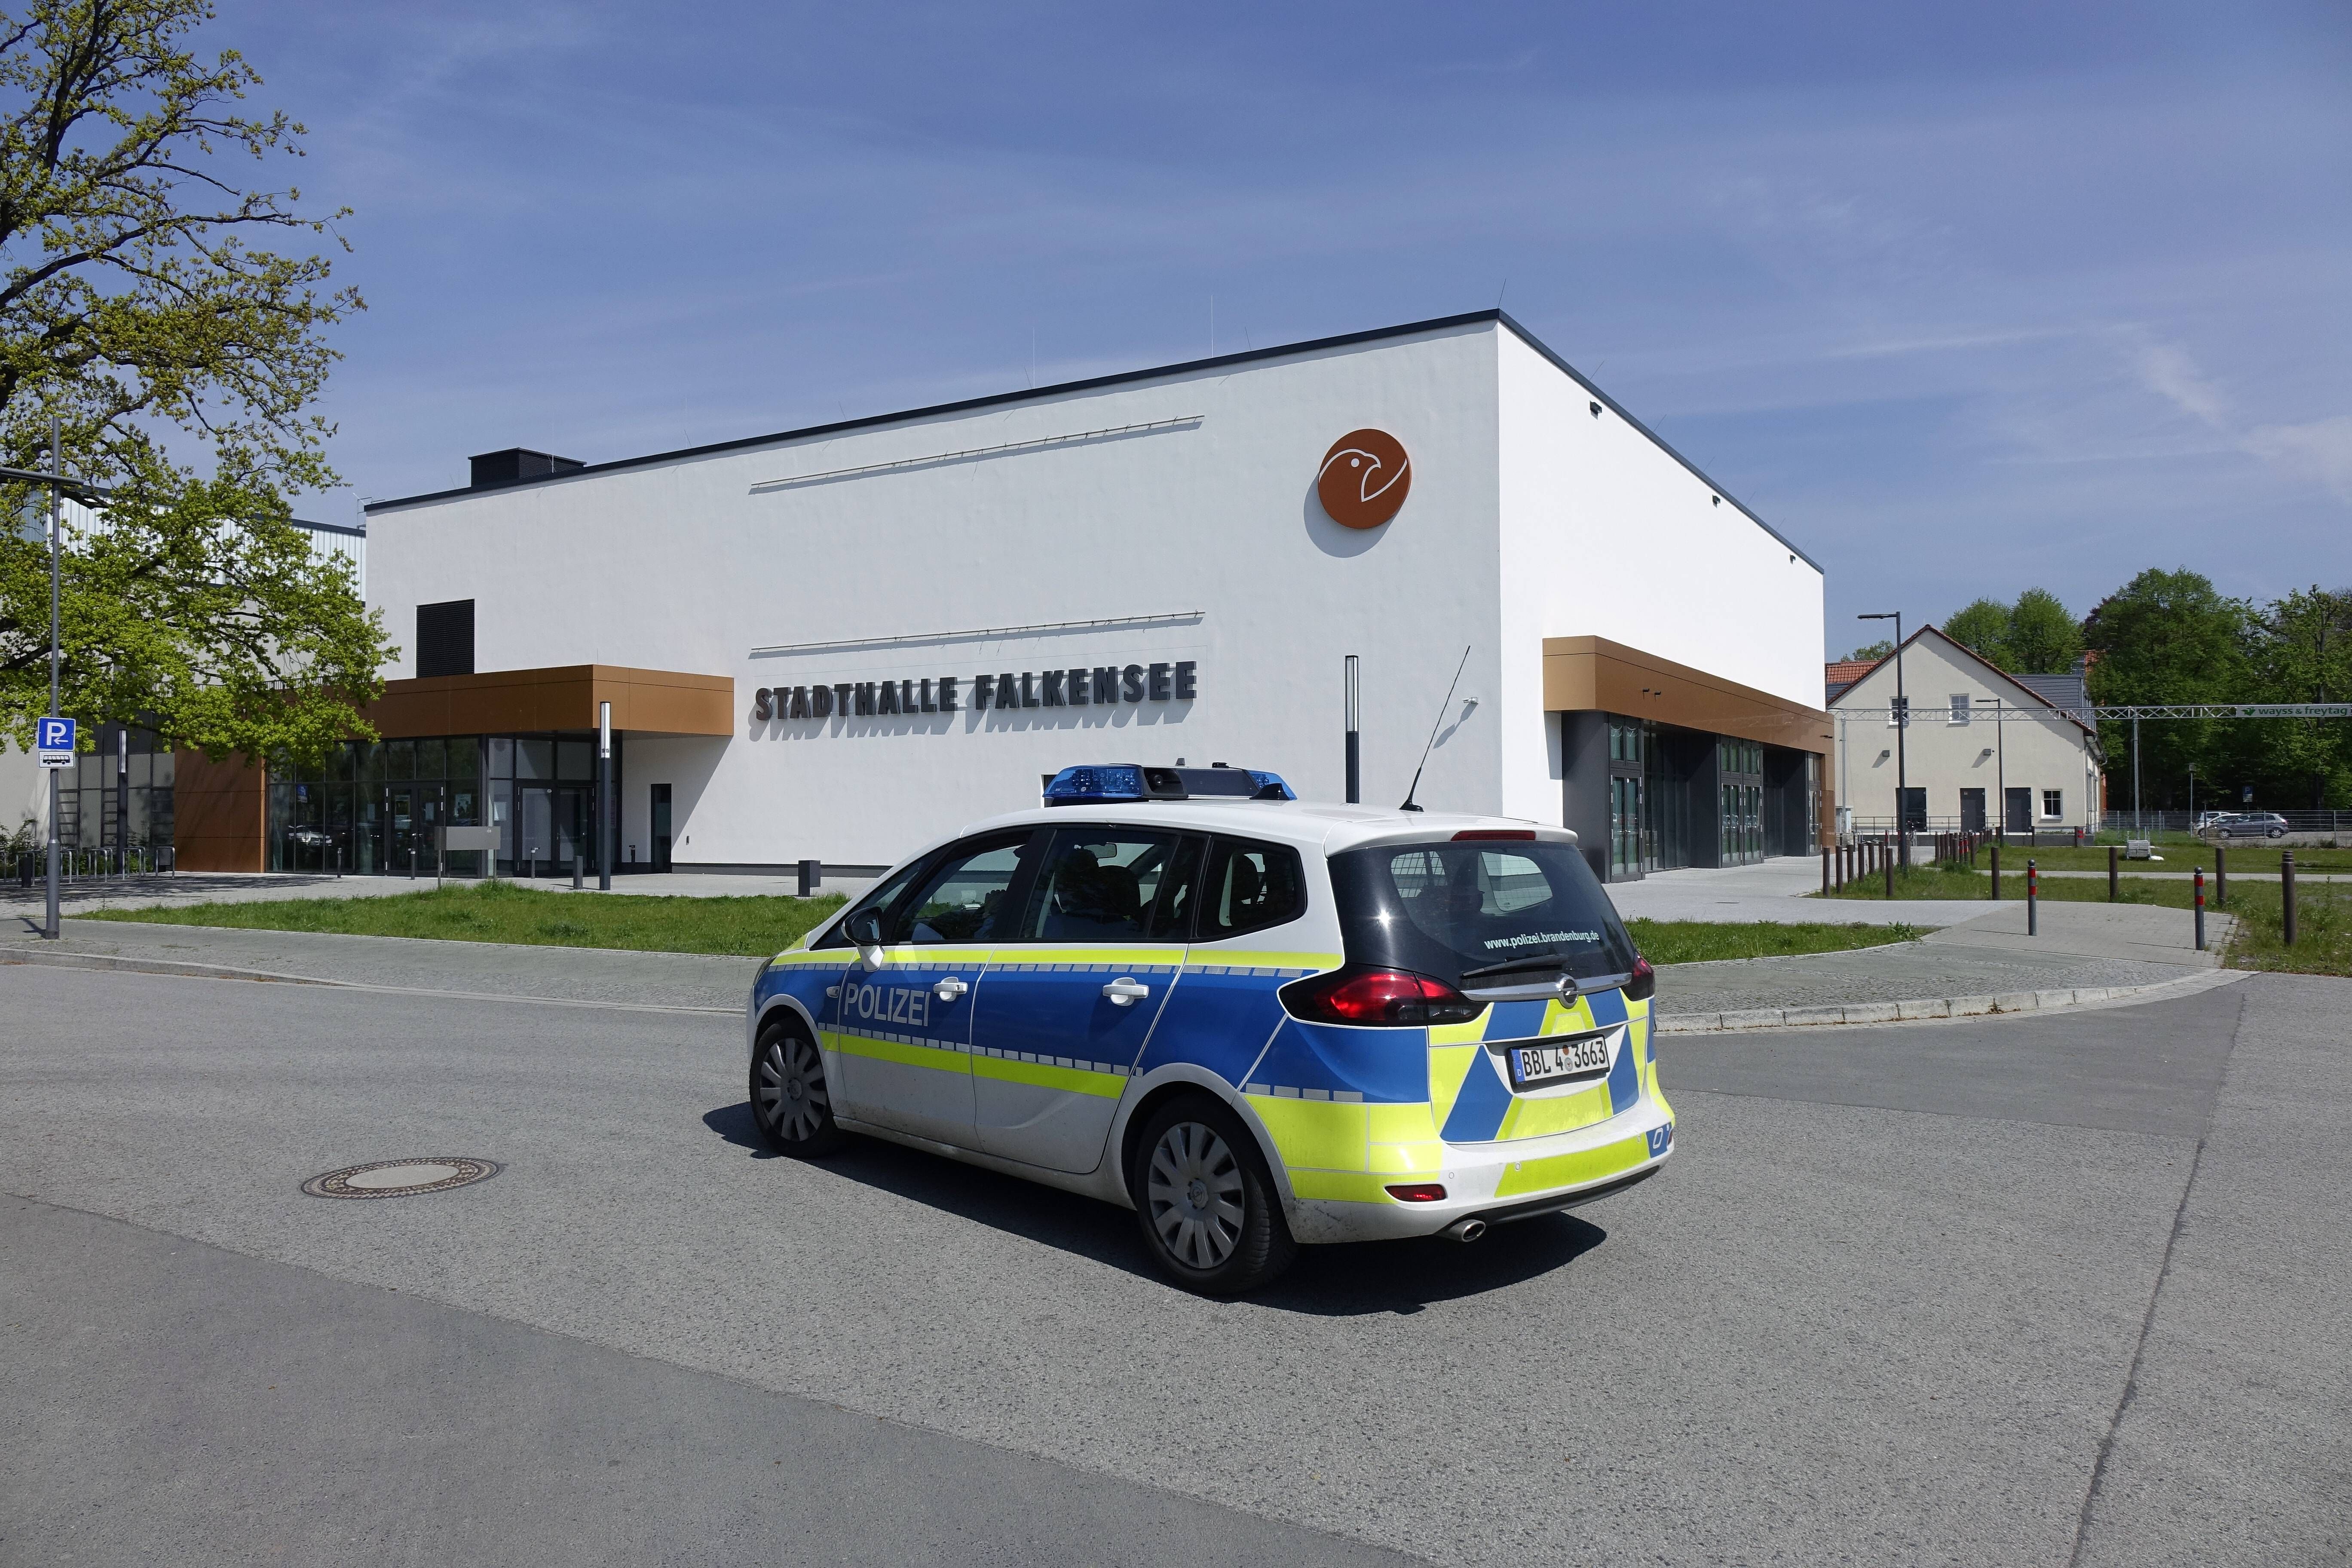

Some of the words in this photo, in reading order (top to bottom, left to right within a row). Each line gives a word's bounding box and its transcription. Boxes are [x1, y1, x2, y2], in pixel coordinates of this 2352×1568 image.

[755, 677, 958, 721] STADTHALLE
[975, 661, 1197, 710] FALKENSEE
[2258, 707, 2293, 716] wayss
[2305, 706, 2348, 716] freytag
[46, 722, 67, 746] P
[1484, 930, 1600, 949] www.polizei.brandenburg.de
[844, 983, 931, 1026] POLIZEI
[1522, 1049, 1551, 1076] BBL
[1555, 1047, 1563, 1071] 4
[1571, 1041, 1605, 1068] 3663
